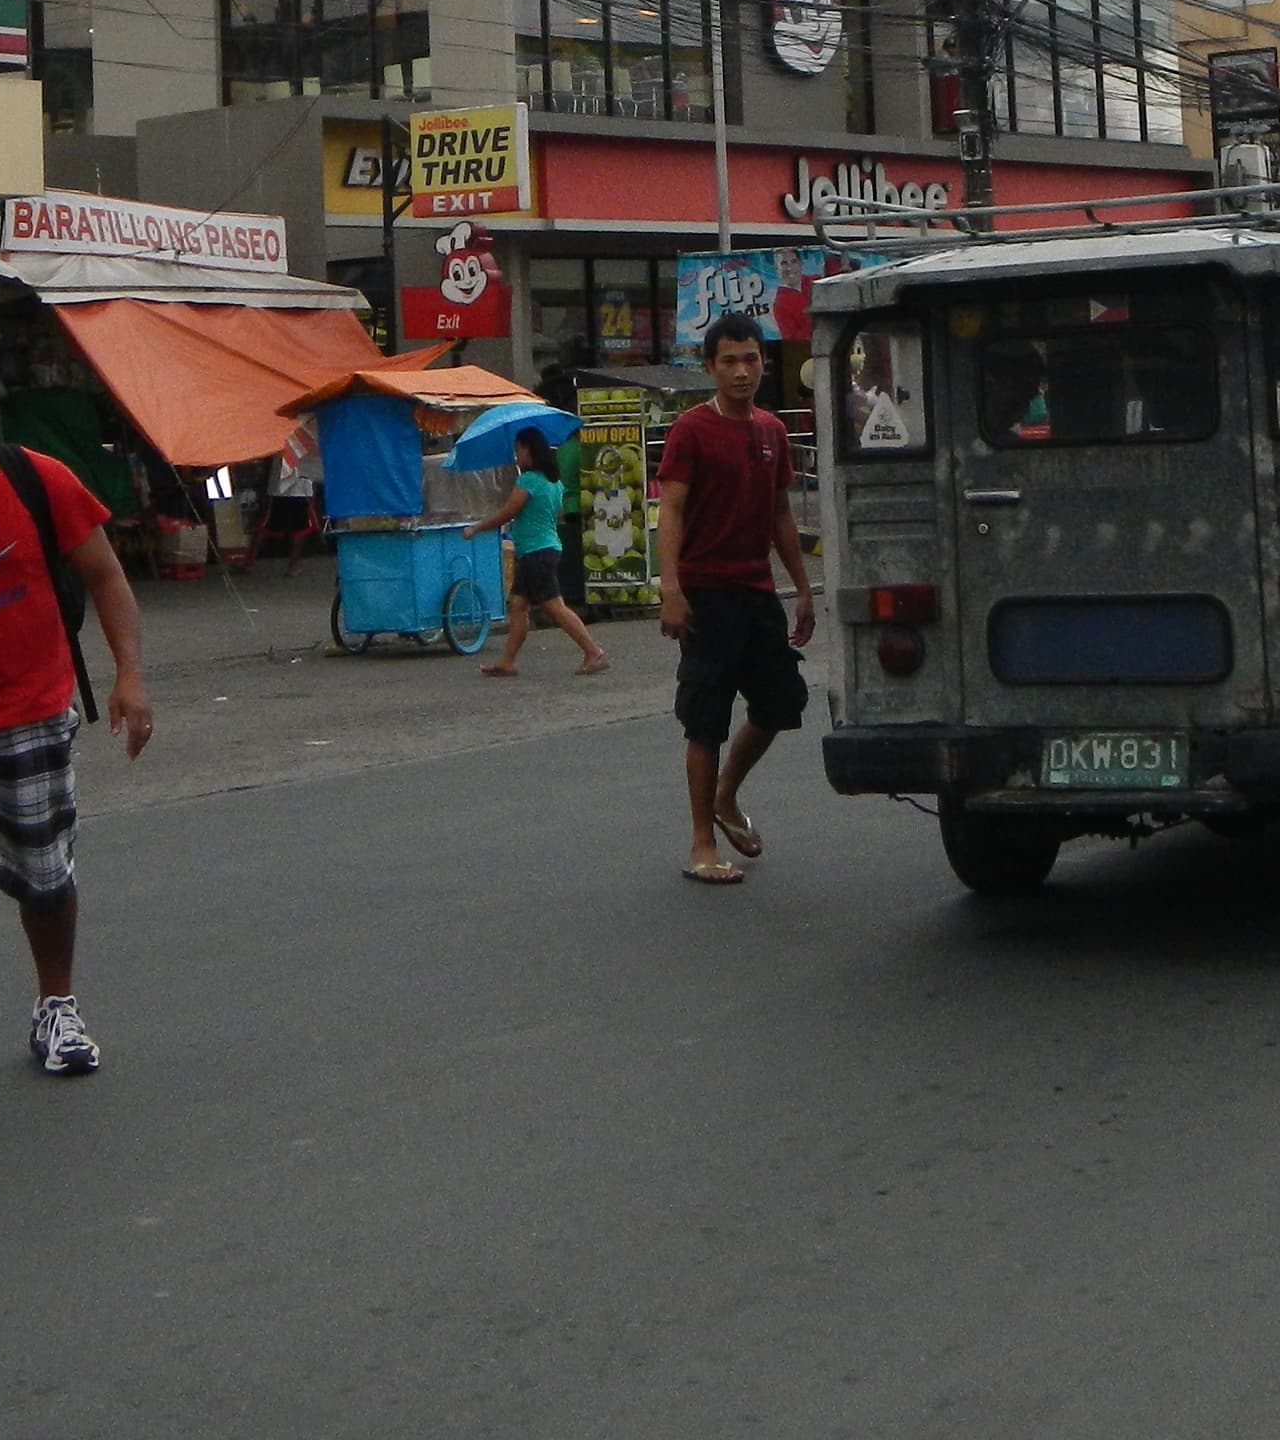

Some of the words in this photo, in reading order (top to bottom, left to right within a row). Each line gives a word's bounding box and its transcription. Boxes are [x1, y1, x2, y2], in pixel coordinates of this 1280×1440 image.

[419, 115, 469, 131] Jollibee
[417, 127, 510, 158] DRIVE
[346, 148, 410, 187] Exi
[421, 157, 505, 186] THRU
[432, 192, 493, 213] EXIT
[784, 156, 949, 224] Jollibee
[205, 224, 280, 262] PASEO
[691, 266, 764, 333] flip
[437, 314, 460, 329] Exit
[601, 304, 633, 336] 24
[579, 428, 608, 443] NOW
[610, 427, 640, 441] OPEN
